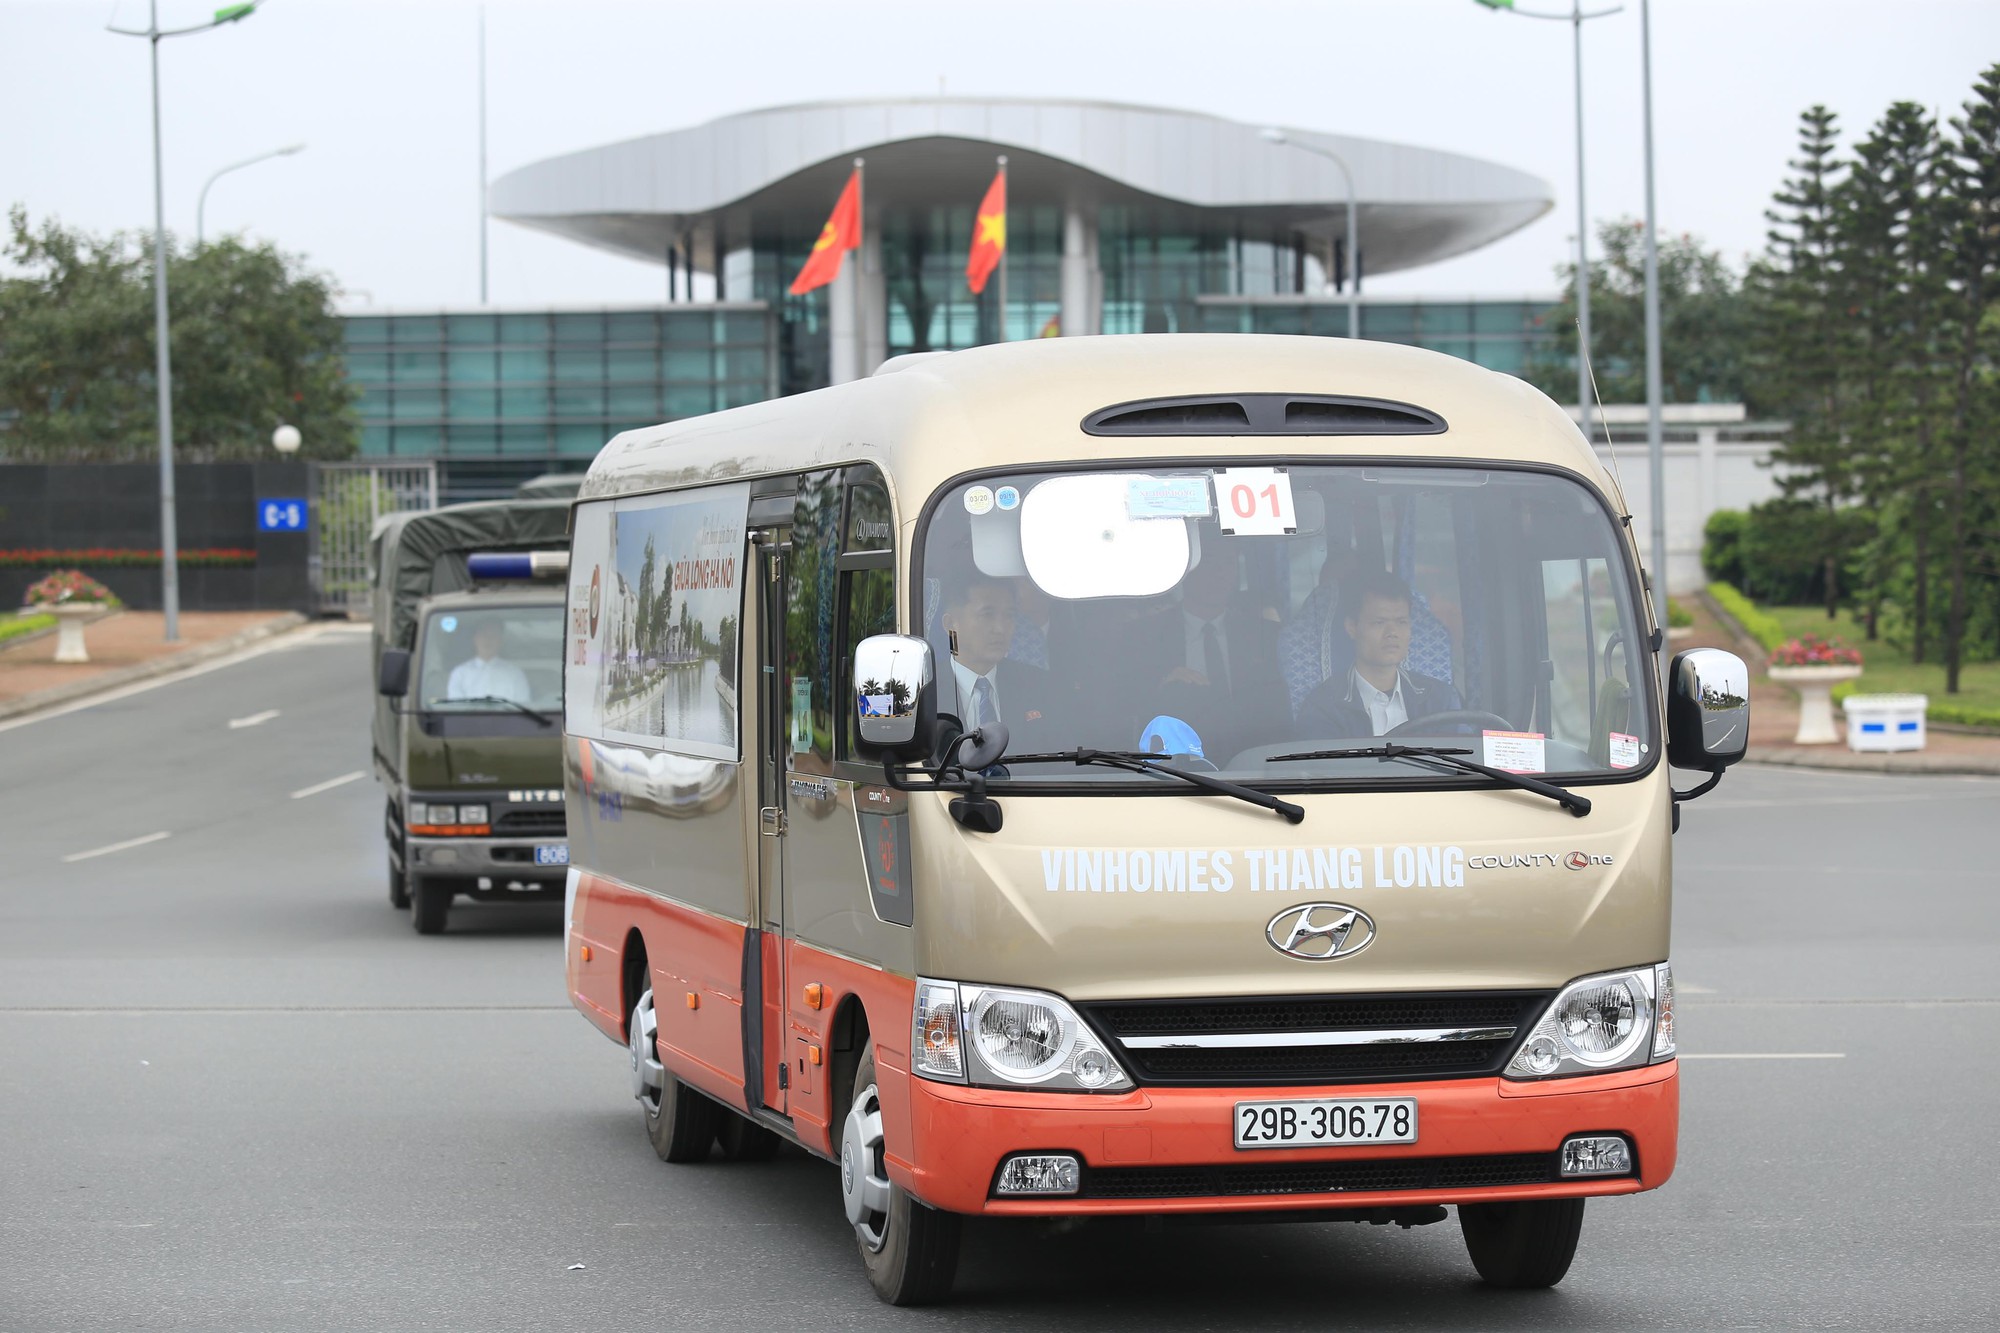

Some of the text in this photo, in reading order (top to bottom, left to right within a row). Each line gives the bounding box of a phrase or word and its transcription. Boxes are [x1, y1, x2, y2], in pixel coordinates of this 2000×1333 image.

[970, 494, 988, 502] 03/20
[1231, 484, 1281, 518] 01
[508, 790, 565, 802] MITS
[1040, 846, 1465, 893] VINHOMES THANG LONG
[1468, 853, 1560, 869] COUNTY
[1242, 1104, 1410, 1141] 29B-306.78
